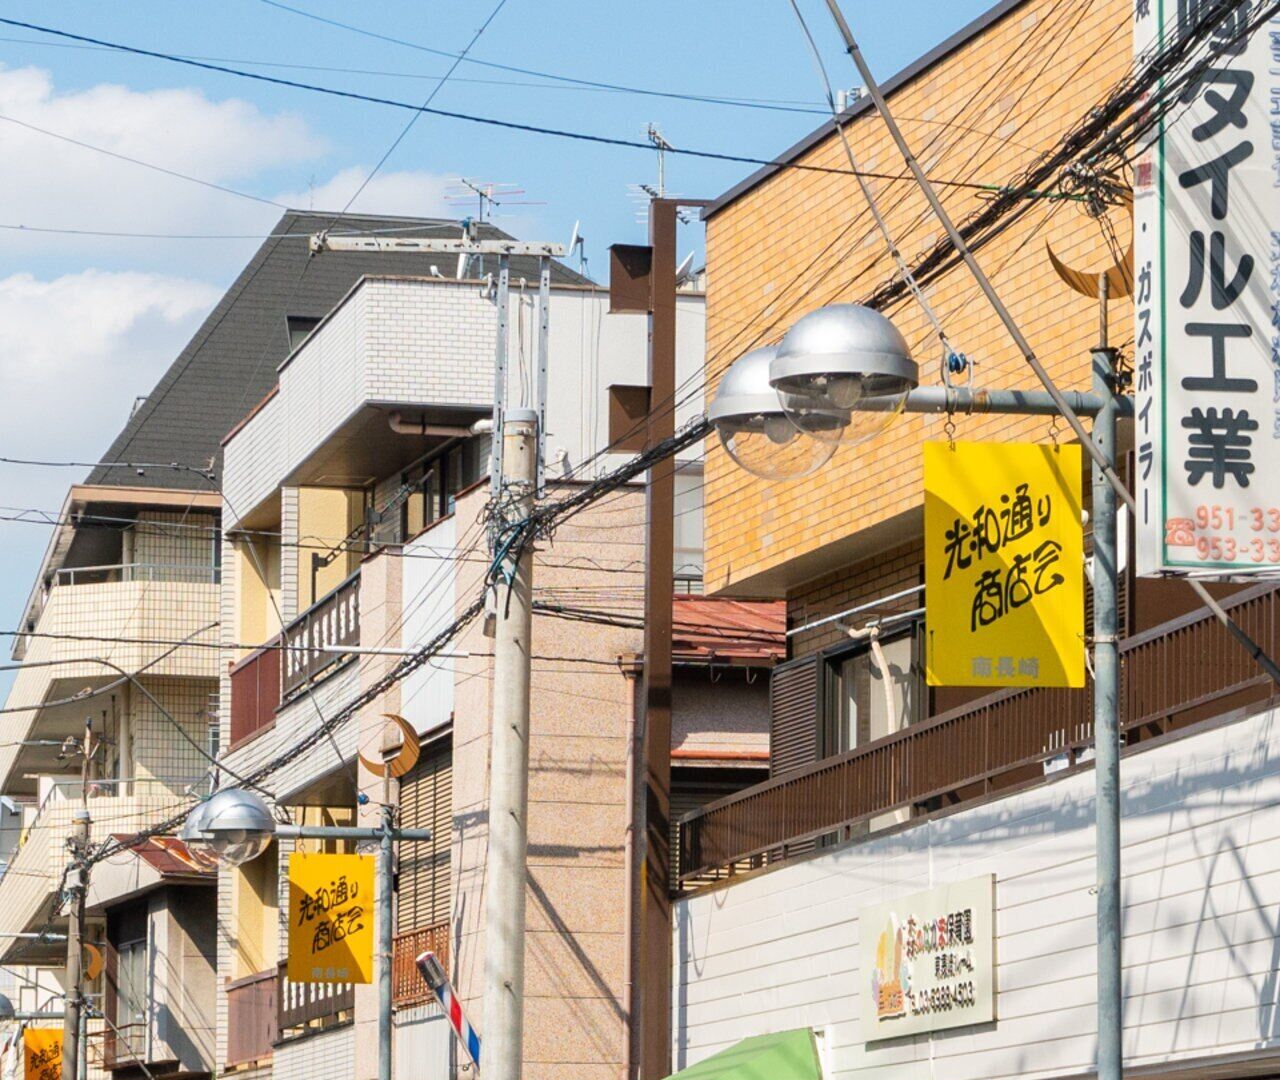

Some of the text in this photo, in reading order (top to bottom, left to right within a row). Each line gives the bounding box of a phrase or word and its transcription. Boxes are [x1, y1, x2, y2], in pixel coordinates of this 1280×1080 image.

[943, 483, 1052, 581] 光和通り
[971, 540, 1065, 632] 商店会
[972, 656, 1039, 679] 南長崎
[312, 906, 364, 955] 商店会
